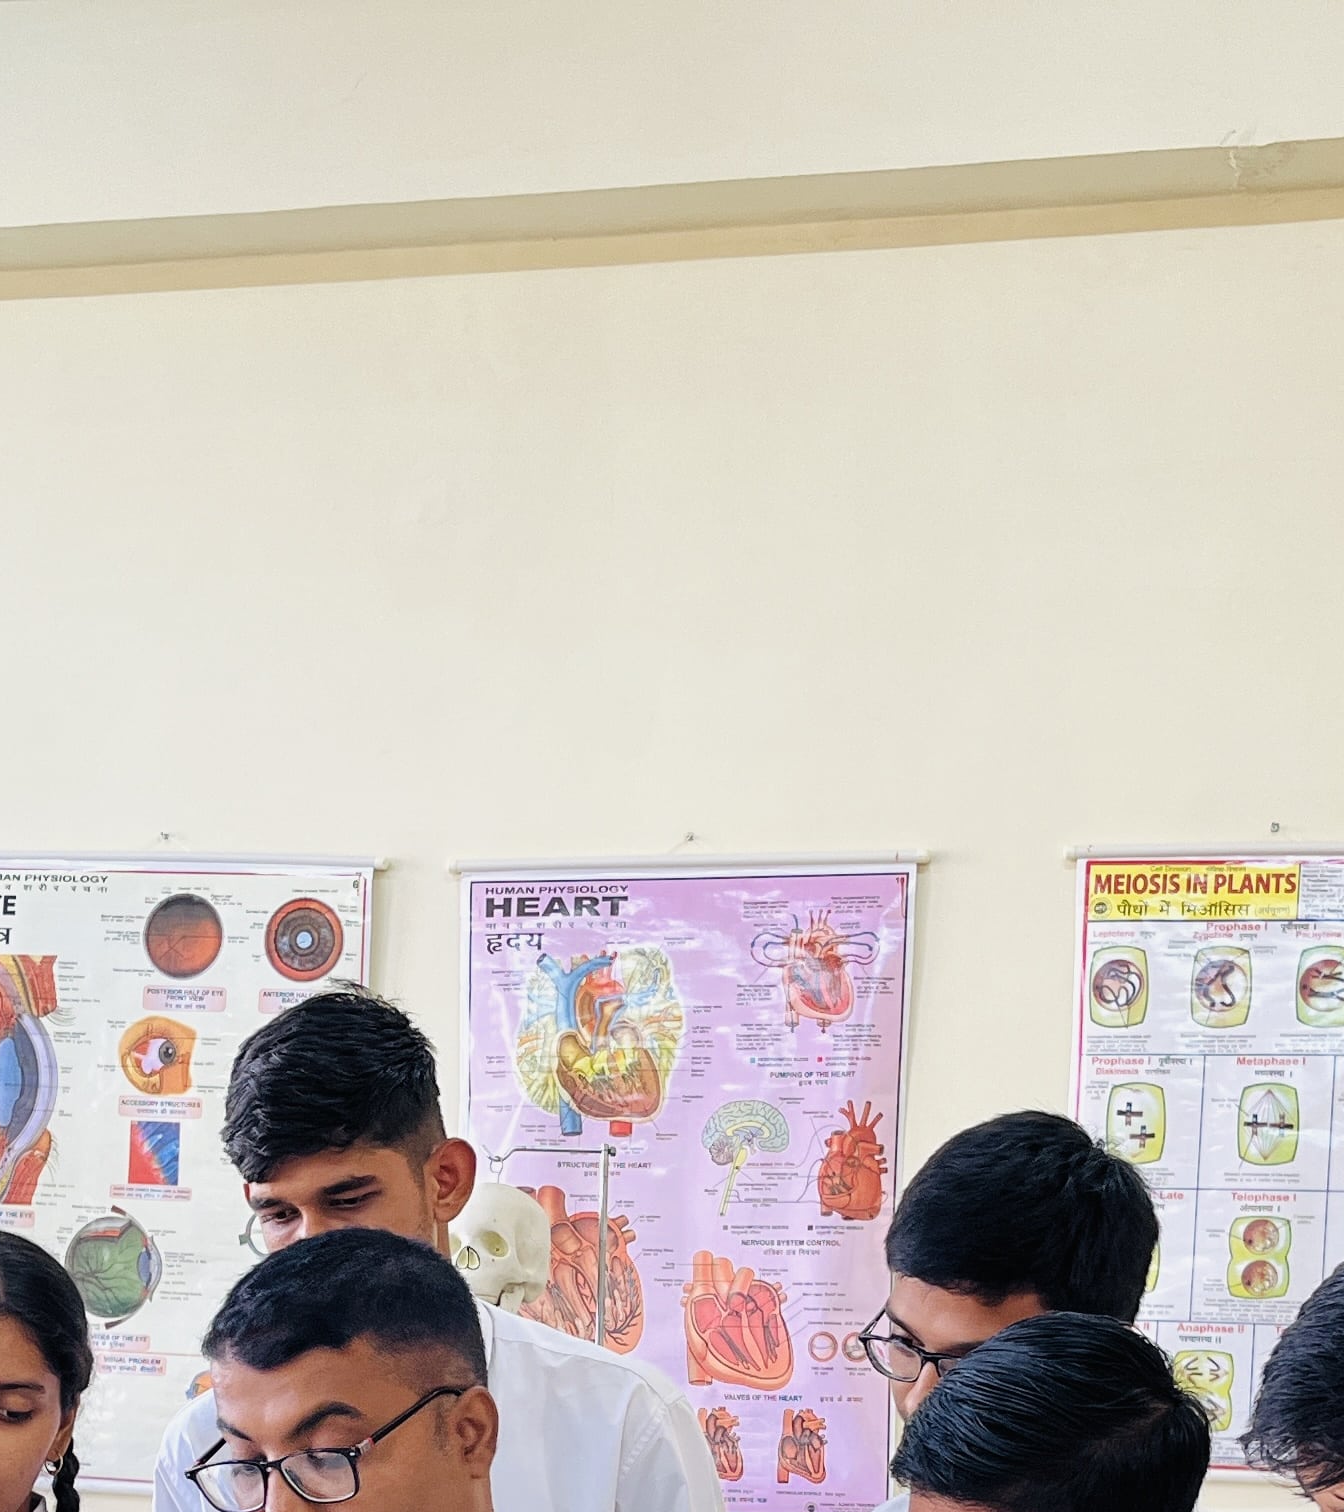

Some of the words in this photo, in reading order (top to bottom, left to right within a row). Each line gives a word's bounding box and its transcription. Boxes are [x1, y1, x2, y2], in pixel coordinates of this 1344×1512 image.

[24, 874, 109, 883] PHYSIOLOGY
[1094, 873, 1180, 894] MEIOSIS
[1186, 874, 1208, 894] IN
[1214, 873, 1297, 894] PLANTS
[485, 887, 535, 895] HUMAN
[539, 885, 628, 894] PHYSIOLOGY
[485, 896, 628, 918] HEART
[1206, 923, 1261, 932] Prophase
[485, 933, 545, 954] हृदय
[147, 988, 183, 996] POSTERIOR
[1091, 1057, 1144, 1066] Prophase
[1236, 1057, 1299, 1067] Metaphase
[770, 1071, 803, 1079] PUMPING
[160, 1100, 201, 1108] STRUCTURES
[1160, 1192, 1184, 1200] Late
[1232, 1192, 1289, 1203] Telophase
[1177, 1323, 1234, 1334] Anaphase
